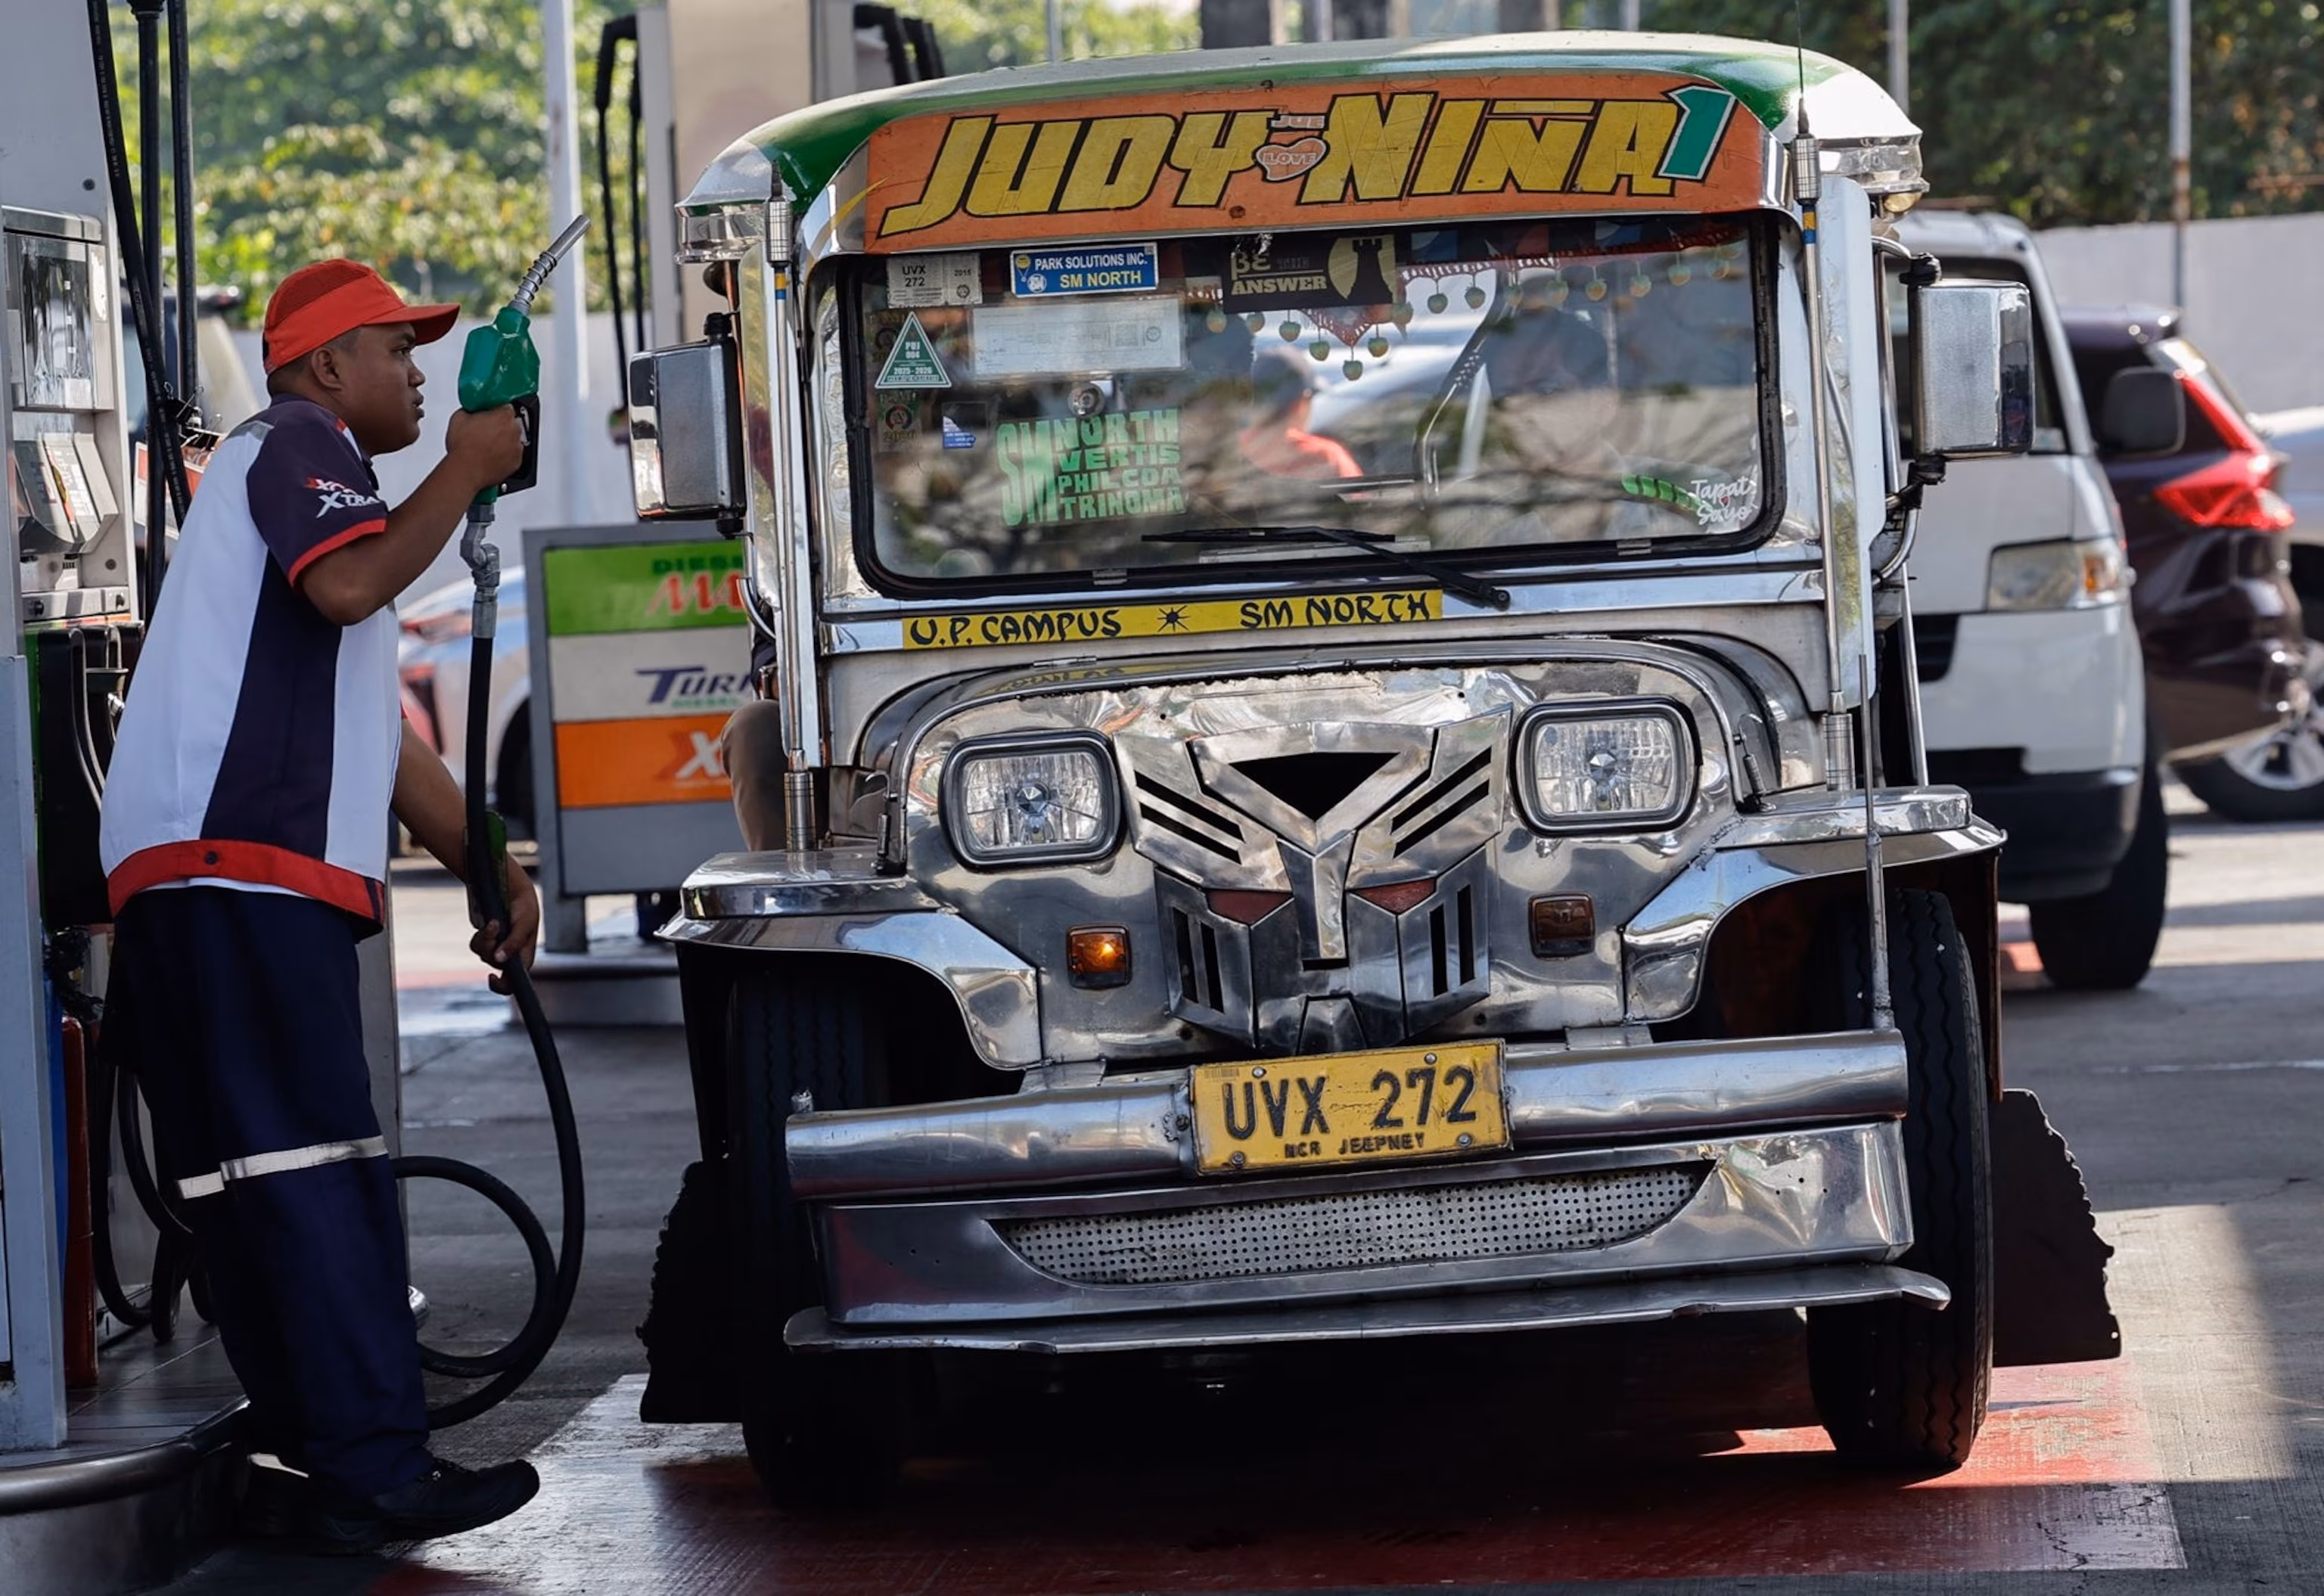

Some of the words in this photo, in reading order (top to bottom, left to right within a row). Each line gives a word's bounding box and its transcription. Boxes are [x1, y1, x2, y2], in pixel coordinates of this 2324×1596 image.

[880, 110, 1276, 238] JUDY
[1663, 85, 1735, 180] 1
[1262, 152, 1317, 166] LOVE
[903, 265, 926, 275] UVX
[1034, 257, 1062, 270] PARK
[1065, 252, 1124, 269] SOLUTIONS
[1126, 252, 1148, 265] INC.
[905, 277, 925, 287] 272
[1060, 274, 1083, 288] SM
[1087, 270, 1141, 287] NORTH
[1231, 275, 1328, 295] ANSWER
[905, 342, 920, 350] PUJ
[1055, 408, 1179, 451] NORTH
[1061, 445, 1181, 473] VERTIS
[997, 421, 1058, 526] SM
[1059, 467, 1182, 495] PHILCOA
[1060, 487, 1185, 520] TRINOMA
[1691, 476, 1748, 505] Tapat
[316, 492, 380, 518] XTRA
[1240, 601, 1294, 629] SM
[1306, 592, 1432, 625] NORTH
[910, 619, 973, 645] U.P.
[983, 610, 1122, 643] CAMPUS
[1223, 1076, 1329, 1139] UVX
[1371, 1066, 1476, 1130] 272
[1285, 1141, 1322, 1158] NCR
[1338, 1132, 1425, 1156] JEEPNEY
